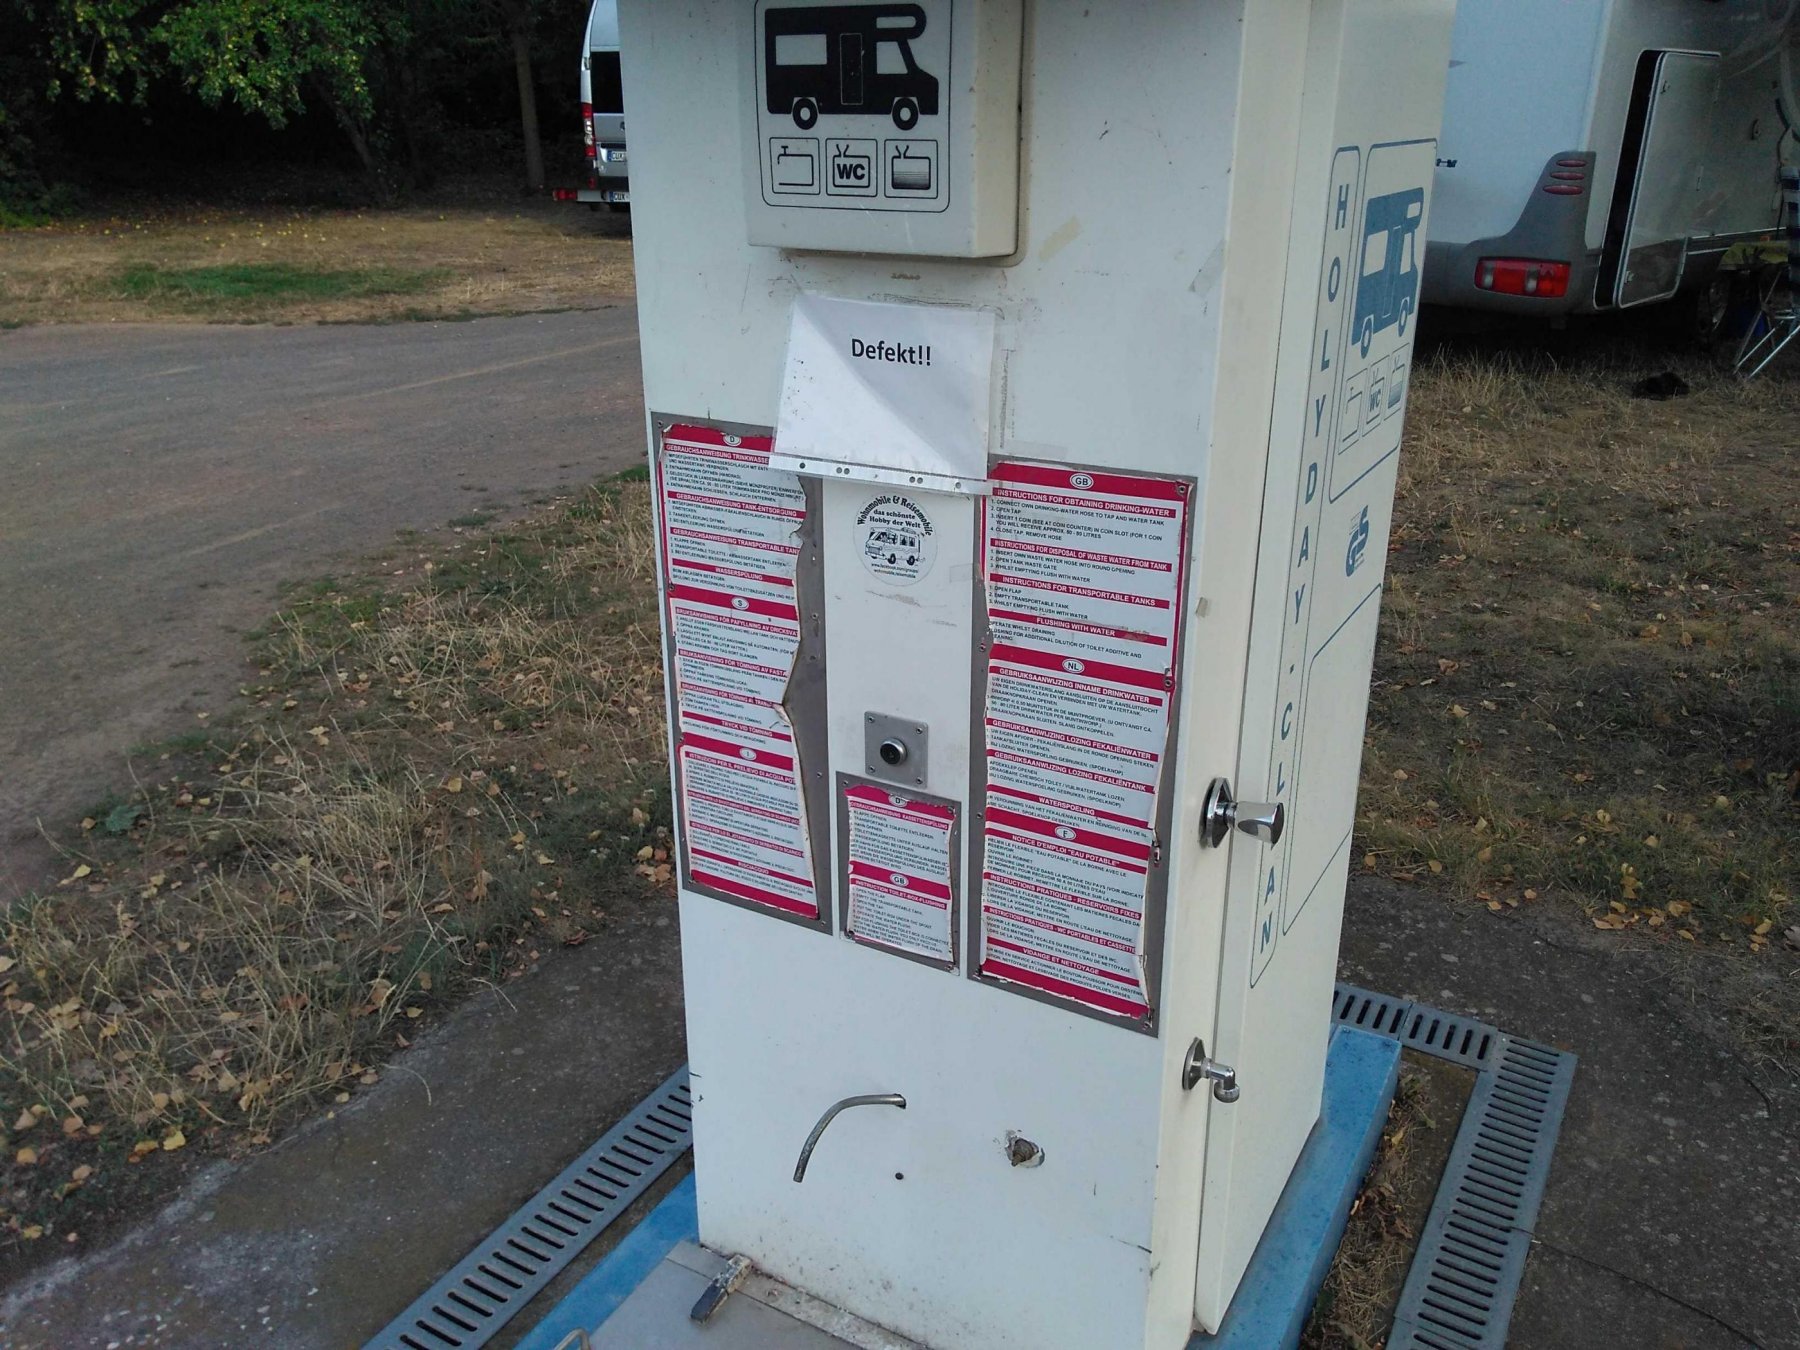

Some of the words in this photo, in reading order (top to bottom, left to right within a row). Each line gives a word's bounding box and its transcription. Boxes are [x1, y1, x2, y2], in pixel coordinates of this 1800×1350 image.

[836, 163, 866, 180] WC
[851, 338, 931, 367] Defekt!!
[1369, 388, 1381, 412] WC
[732, 453, 768, 464] TRINKWASSE
[1075, 476, 1088, 486] GB
[857, 495, 892, 525] Wohnmobile
[892, 495, 900, 504] &
[900, 497, 933, 536] Reisemobile
[886, 510, 916, 520] schönste
[997, 489, 1047, 501] INSTRUCTIONS
[1048, 495, 1063, 503] FOR
[1064, 497, 1103, 508] OBTAINING
[1104, 502, 1169, 517] DRINKING-WATER
[869, 516, 891, 525] Hobby
[905, 520, 921, 529] Welt
[994, 539, 1034, 551] INSTRUCTIONS
[1036, 545, 1047, 553] FOR
[1049, 547, 1076, 557] DISPOSAL
[1077, 551, 1085, 559] OF
[1086, 552, 1107, 562] WASTE
[1108, 555, 1130, 565] WATER
[1131, 558, 1149, 568] FROM
[1150, 561, 1166, 570] TANK
[1002, 576, 1051, 590] INSTRUCTIONS
[1052, 583, 1066, 592] FOR
[1068, 586, 1129, 602] TRANSPORTABLE
[1130, 595, 1155, 606] TANKS
[1036, 617, 1069, 628] FLUSHING
[1071, 623, 1088, 632] WITH
[1090, 626, 1115, 636] WATER
[1067, 662, 1078, 670] NL
[999, 668, 1073, 688] GEBRUIKSAANWIJZING
[1074, 682, 1100, 694] INNAME
[1102, 688, 1149, 703] DRINKWATER
[992, 719, 1064, 741] GEBRUIKSAANWIJZING
[1066, 735, 1091, 746] LOZING
[994, 751, 1066, 773] GEBRUIKSAANWIJZING
[1068, 768, 1092, 779] LOZING
[1038, 797, 1094, 815] WATERSPOELING
[1012, 835, 1035, 845] NOTICE
[990, 873, 1035, 891] INSTRUCTIONS
[1036, 886, 1072, 901] PRATIQUES
[1076, 897, 1118, 913] RESERVOIRS
[1120, 908, 1139, 919] FIXES
[1024, 917, 1053, 930] PRATIQUES
[1066, 929, 1098, 943] PORTABLES
[1023, 947, 1050, 960] VIDANGE
[1060, 958, 1098, 975] NETTOYAGE
